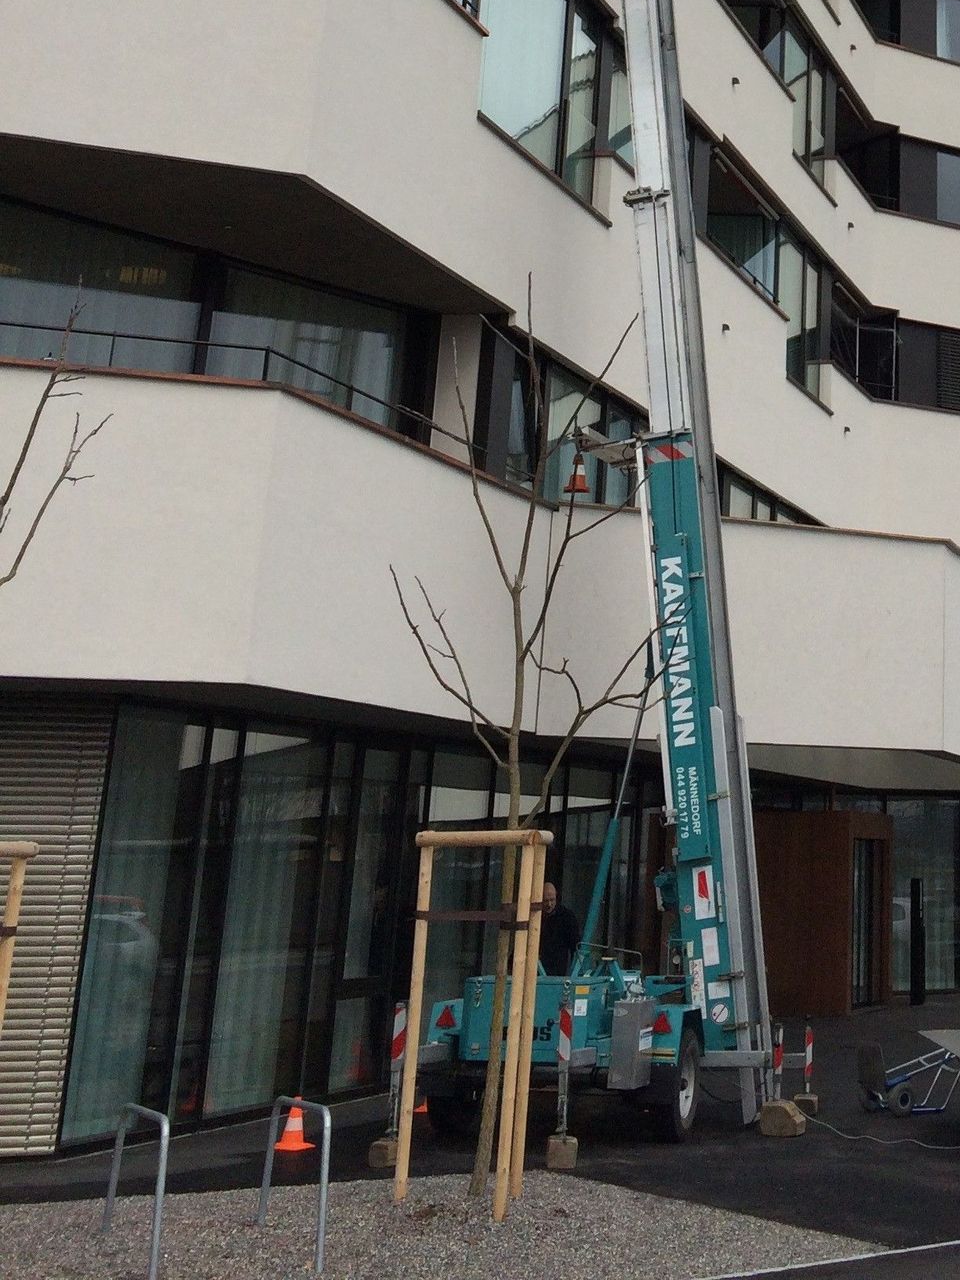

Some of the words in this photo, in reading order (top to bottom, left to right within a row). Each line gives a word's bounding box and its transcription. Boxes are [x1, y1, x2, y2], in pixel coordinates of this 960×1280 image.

[660, 556, 696, 748] KAUFMANN
[676, 766, 685, 787] 044
[678, 789, 687, 809] 920
[688, 766, 701, 835] MÄNNEDORF
[680, 811, 688, 823] 17
[681, 825, 689, 839] 79
